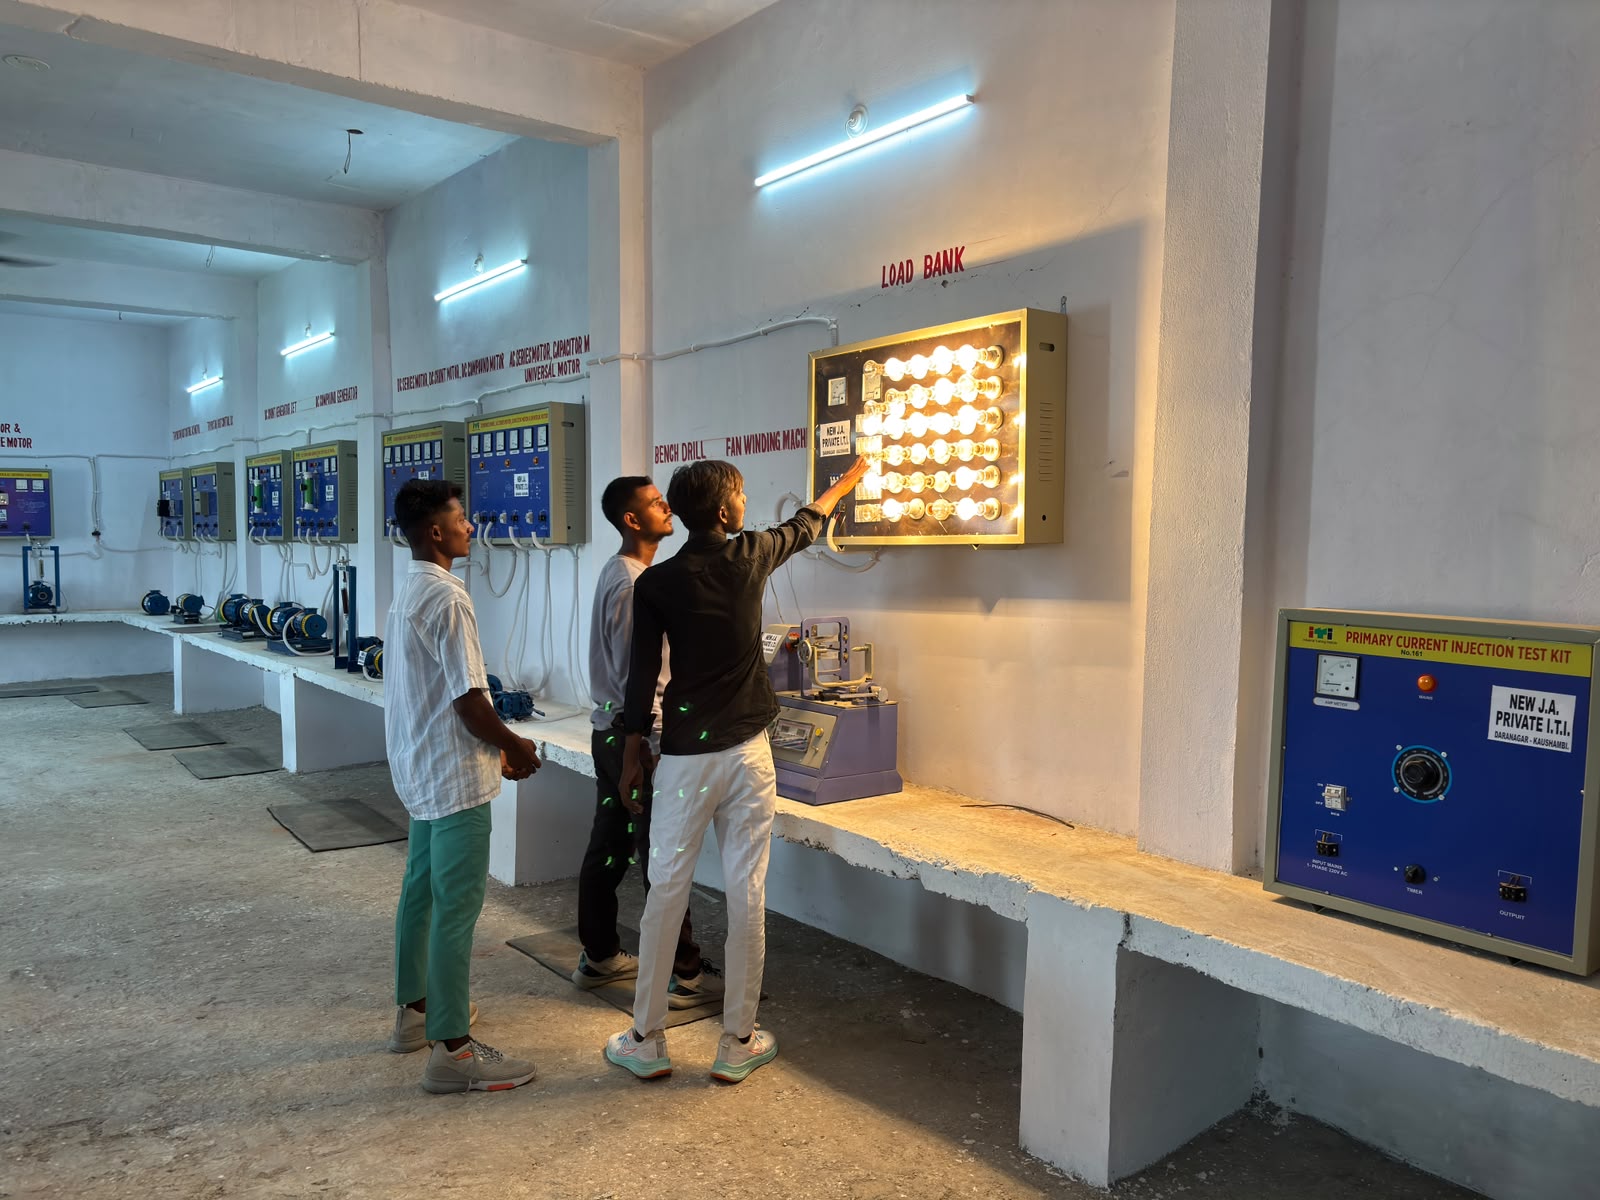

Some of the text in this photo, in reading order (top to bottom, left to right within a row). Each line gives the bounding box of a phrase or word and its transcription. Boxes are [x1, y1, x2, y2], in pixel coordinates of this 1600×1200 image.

[881, 246, 965, 288] LOAD BANK
[552, 336, 582, 359] CAPACITOR
[524, 358, 581, 383] UNIVERSAL MOTOR
[14, 423, 21, 433] &
[827, 426, 836, 436] NEW
[7, 437, 32, 448] MOTOR
[655, 440, 706, 464] BENCH DRILL
[726, 436, 742, 456] FAN
[744, 431, 780, 455] WINDING
[822, 437, 840, 447] PRIVATE
[1346, 631, 1572, 664] PRIMARY CURRENT INJECTION TEST KIT
[1509, 694, 1559, 716] NEW J.A.
[1496, 710, 1570, 737] PRIVATE I.T.I.
[1494, 731, 1529, 743] DARANAGAR
[1327, 862, 1342, 870] MAINS
[1406, 886, 1423, 895] TIMER
